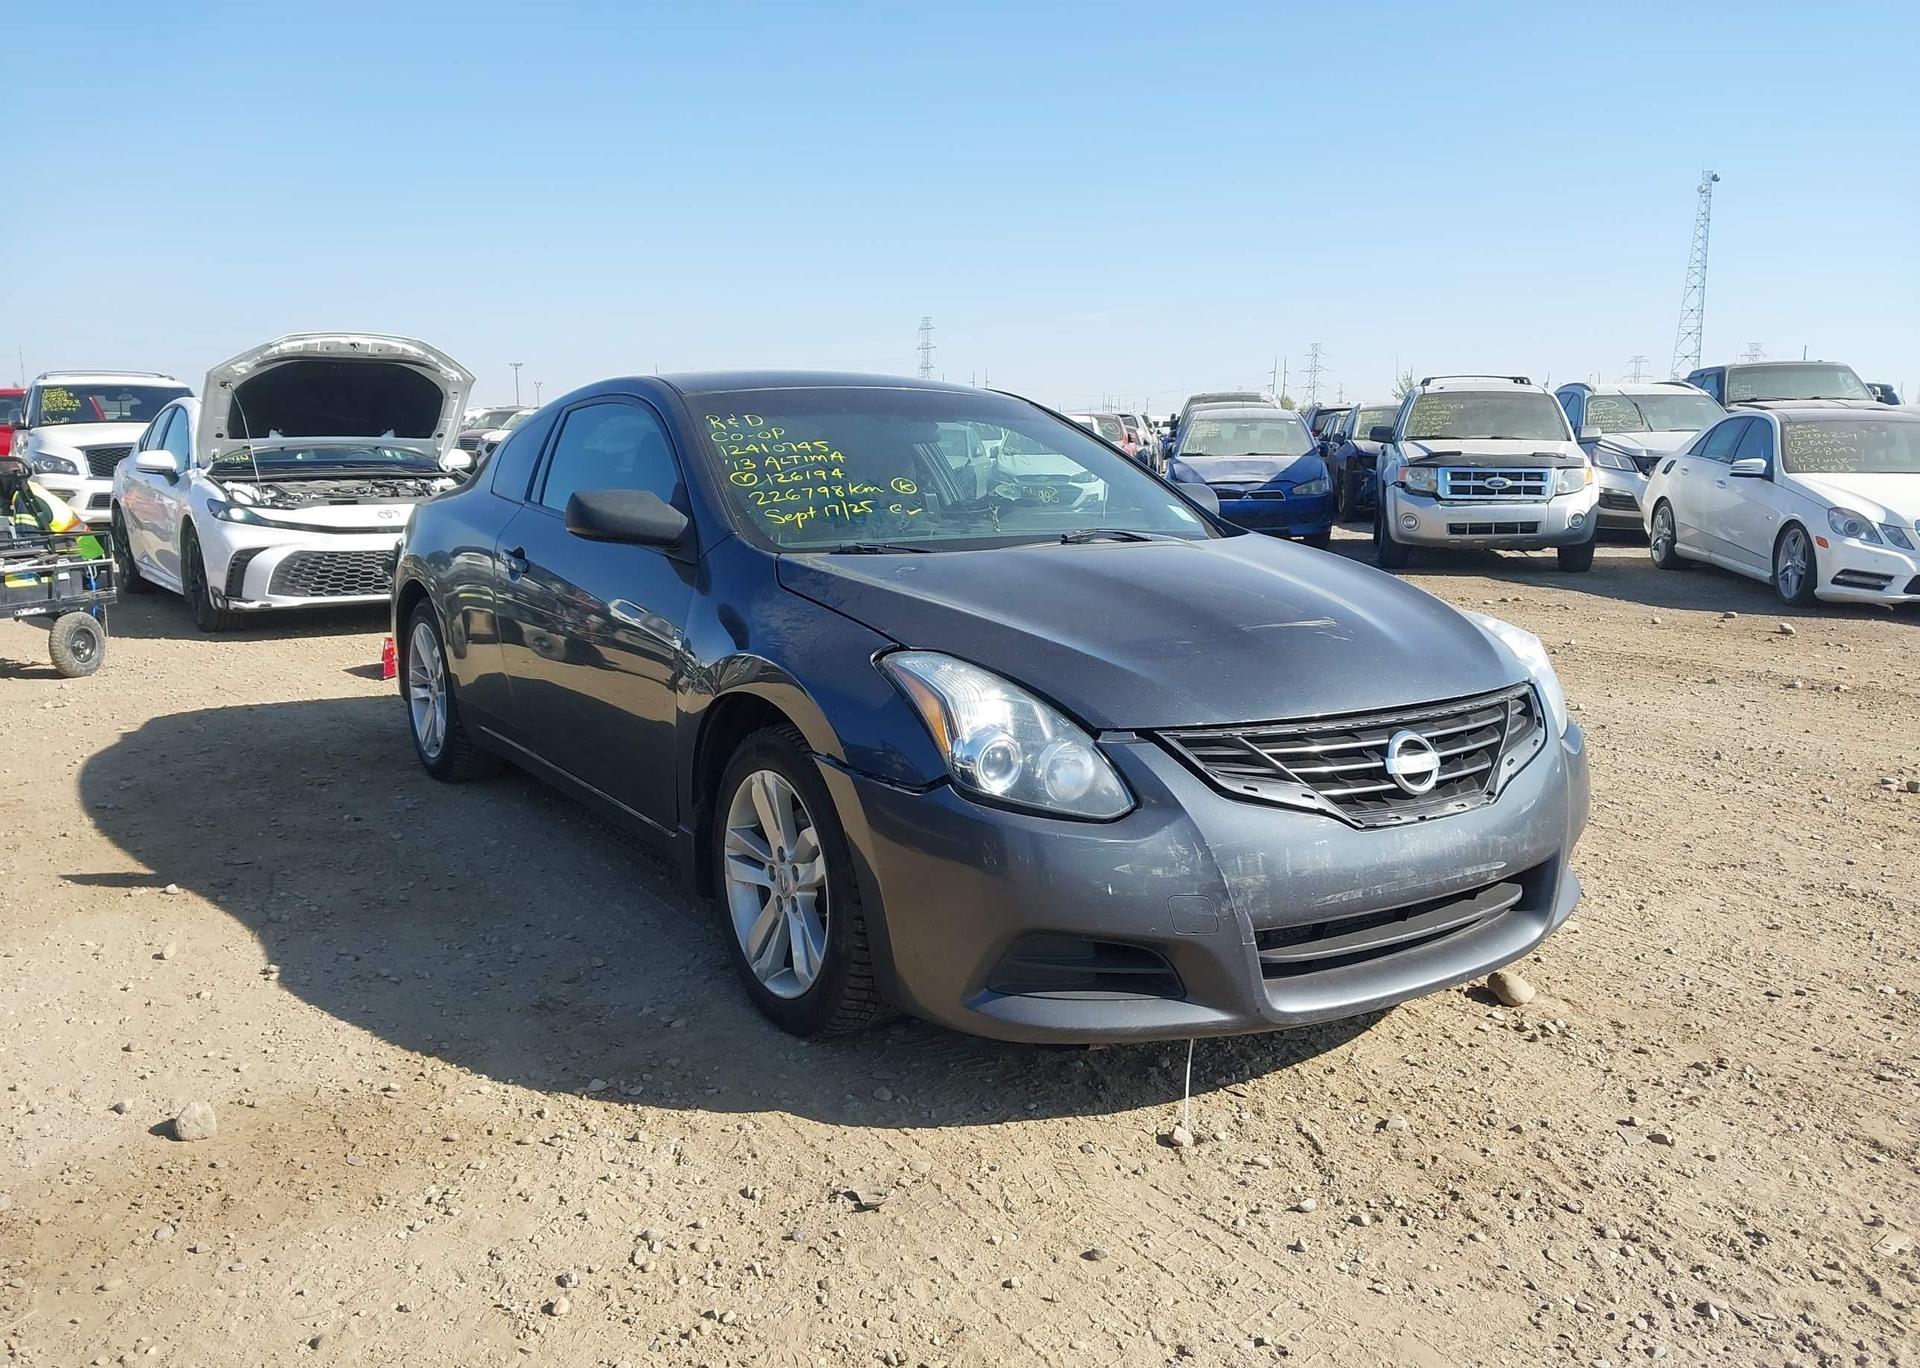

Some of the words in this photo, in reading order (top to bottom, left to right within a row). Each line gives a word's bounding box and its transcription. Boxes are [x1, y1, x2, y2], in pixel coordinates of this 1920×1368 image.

[705, 414, 727, 429] R
[742, 414, 764, 427] D
[720, 440, 830, 457] 12410745
[765, 467, 845, 486] 126194
[763, 506, 818, 529] Sept
[823, 499, 877, 521] 17/25
